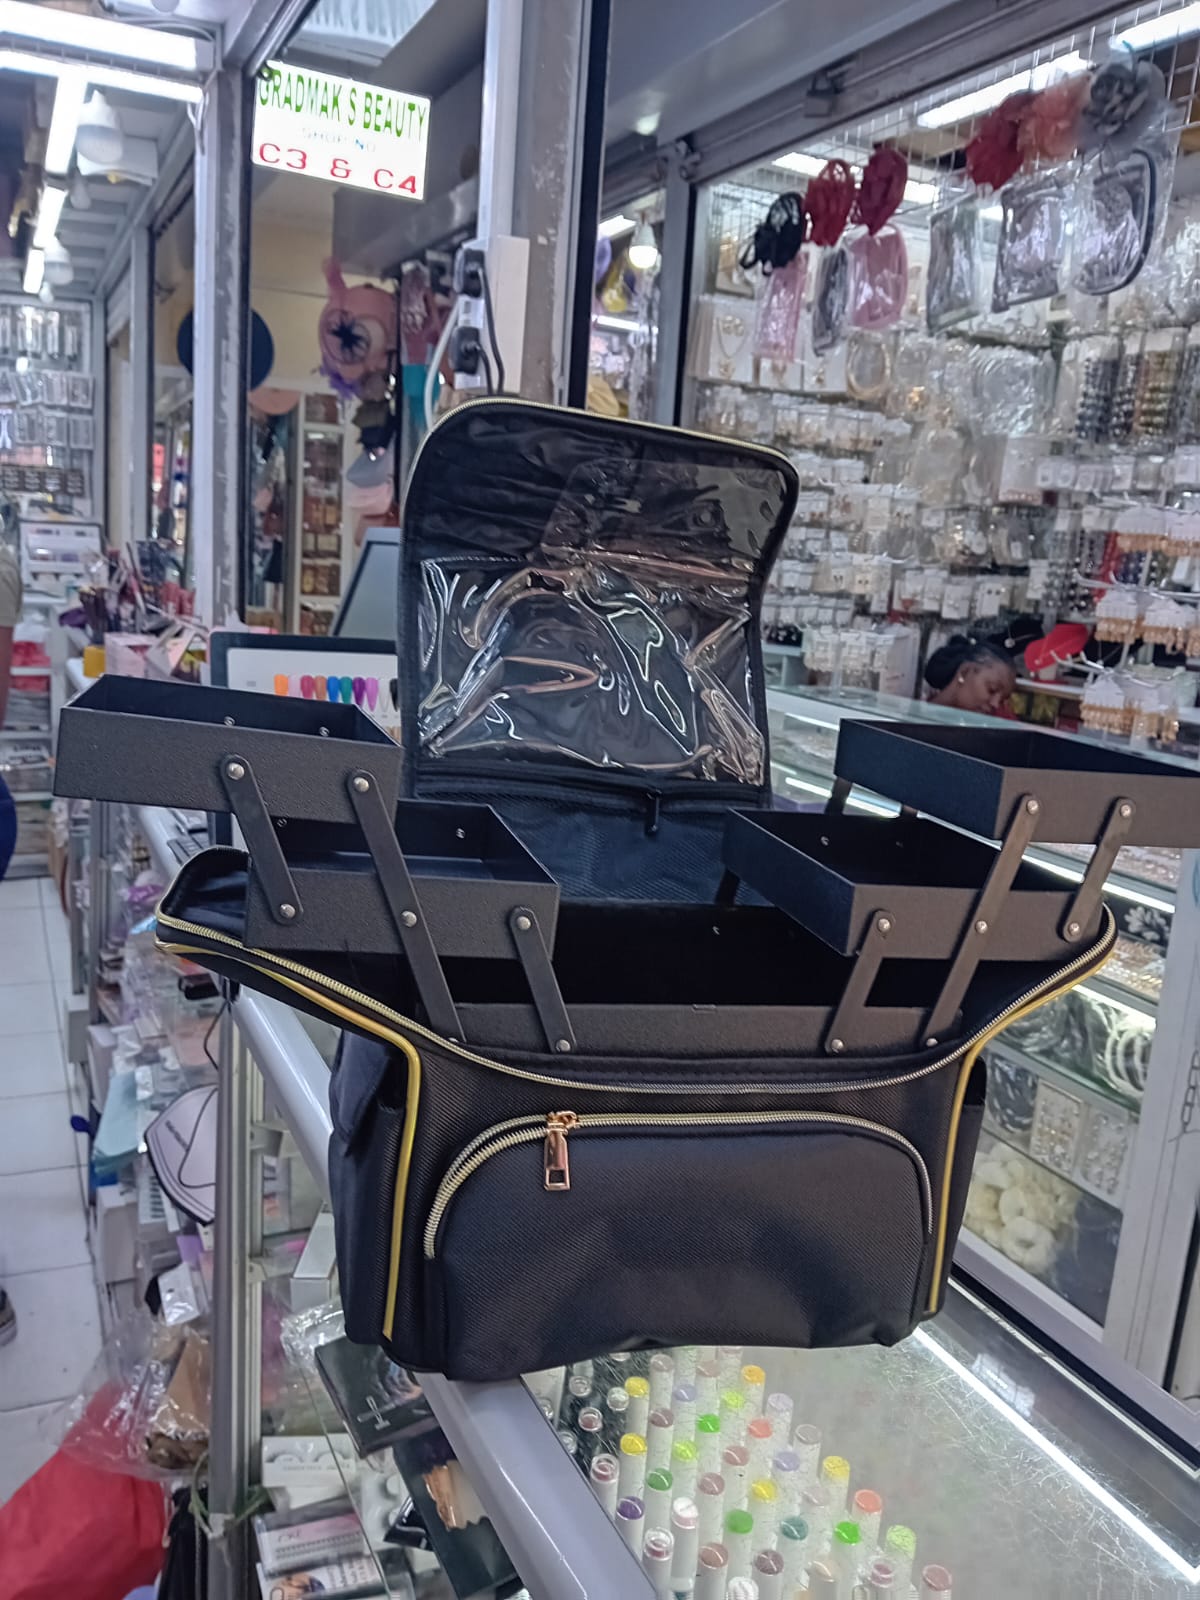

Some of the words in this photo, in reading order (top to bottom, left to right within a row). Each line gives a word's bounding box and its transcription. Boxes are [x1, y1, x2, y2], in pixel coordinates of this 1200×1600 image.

[363, 91, 426, 143] BEAUTY
[259, 142, 307, 169] C3
[330, 158, 351, 178] &
[374, 168, 416, 194] C4
